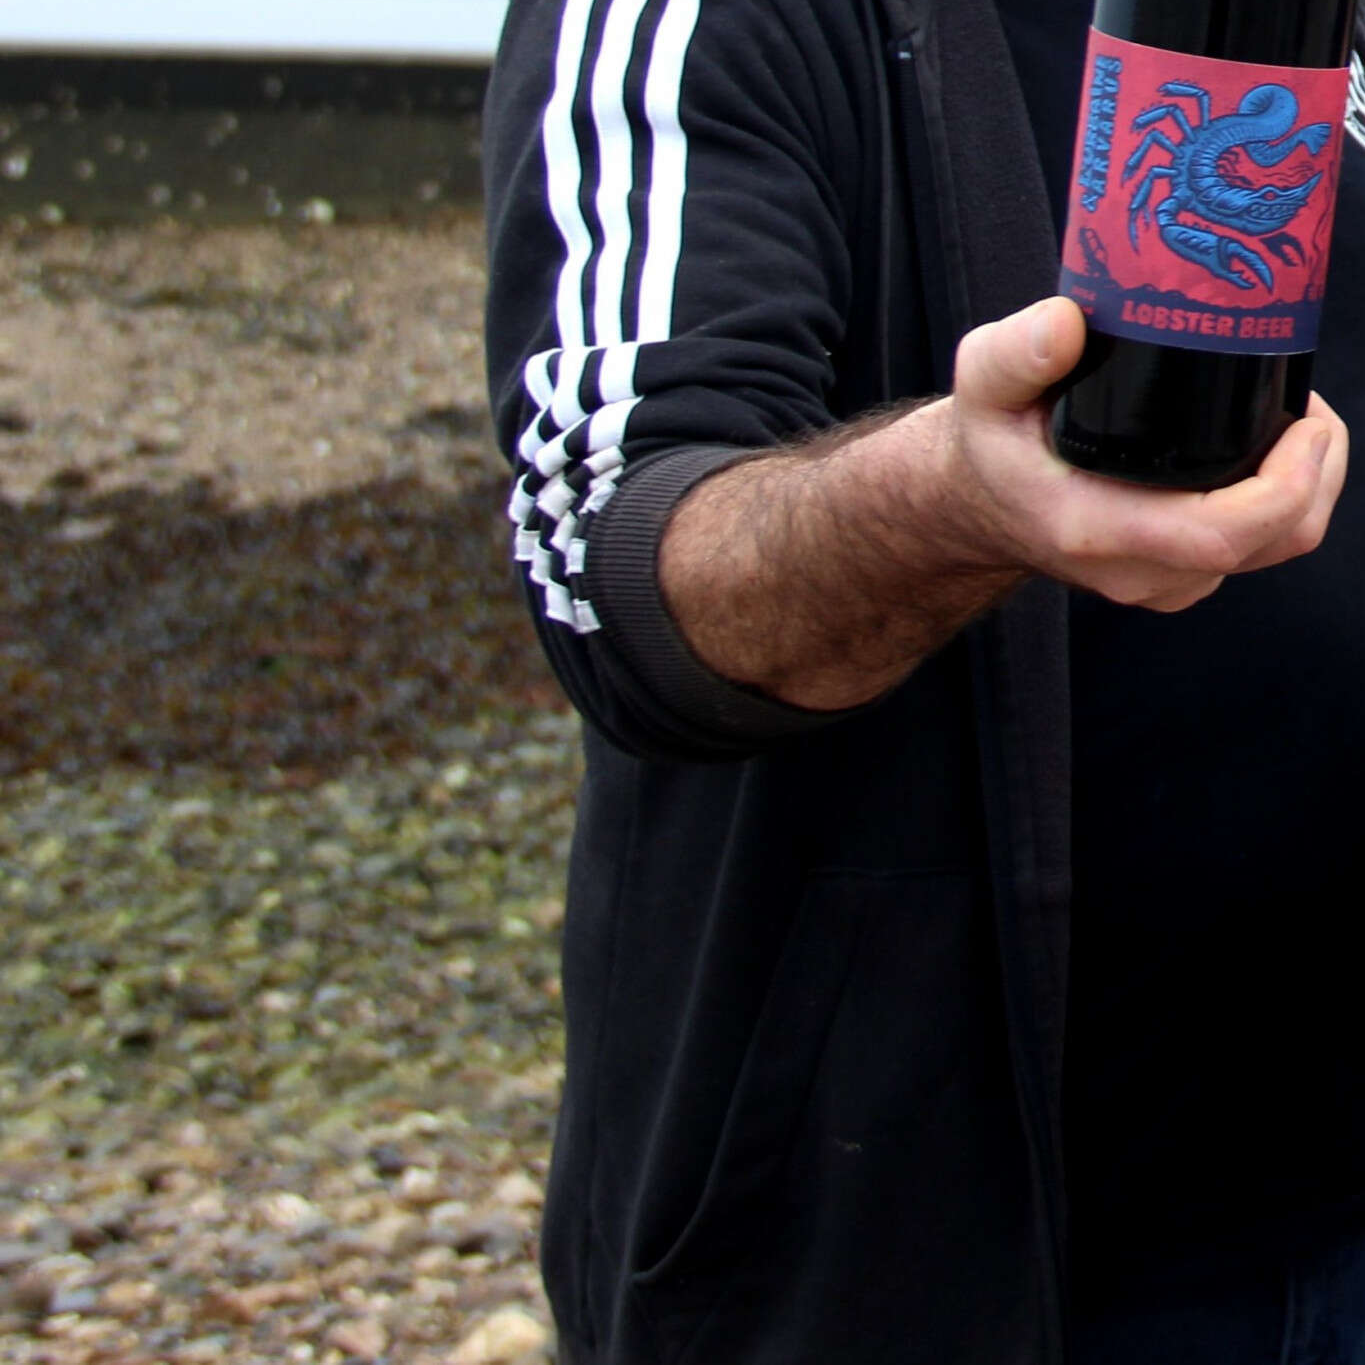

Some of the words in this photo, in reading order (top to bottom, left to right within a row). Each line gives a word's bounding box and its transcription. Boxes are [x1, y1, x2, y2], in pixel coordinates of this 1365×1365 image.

[1092, 59, 1121, 195] ARVARUS
[1121, 300, 1233, 338] LOBSTER
[1239, 317, 1294, 339] BEER
